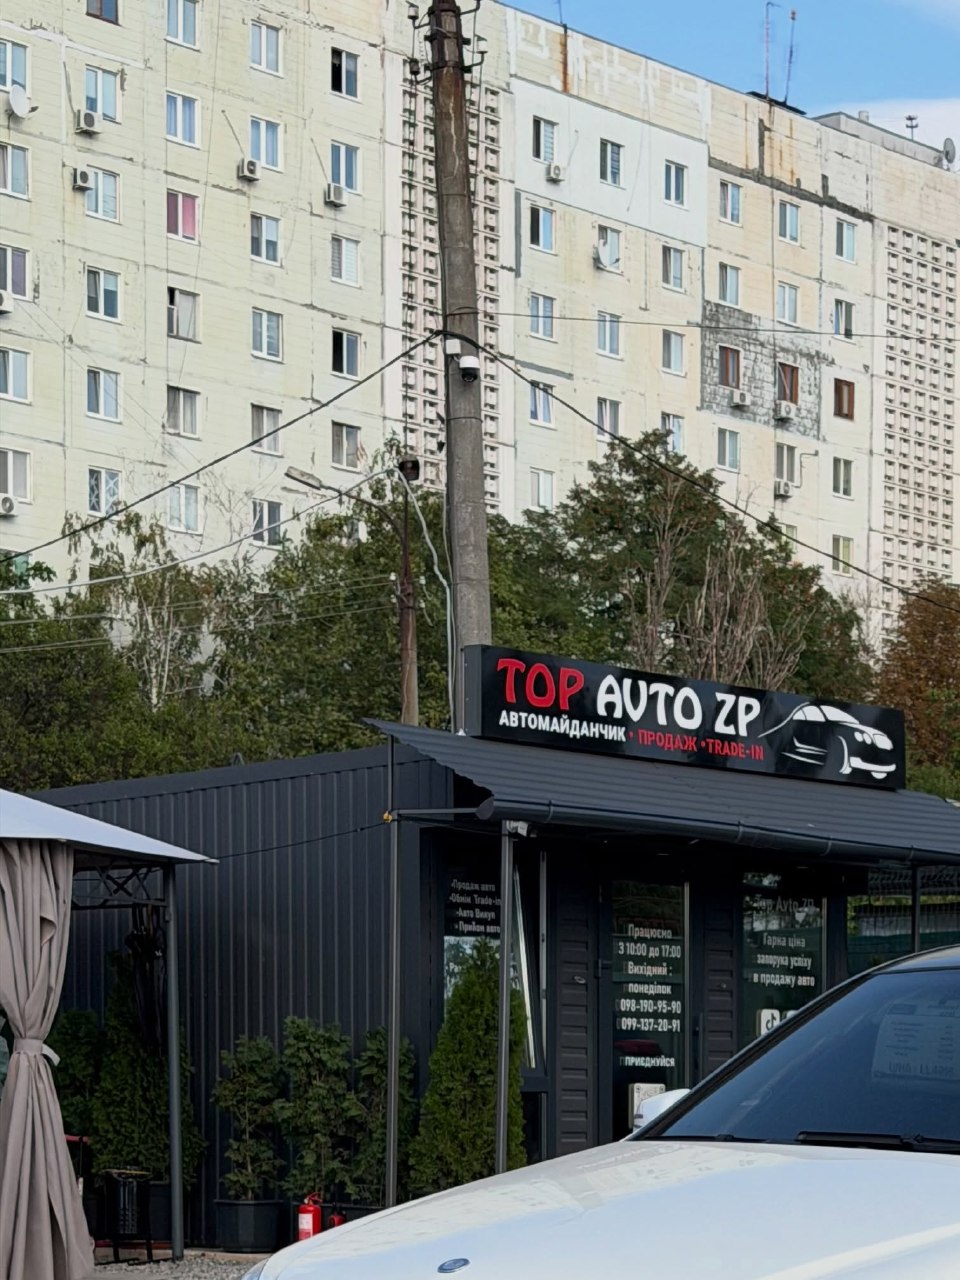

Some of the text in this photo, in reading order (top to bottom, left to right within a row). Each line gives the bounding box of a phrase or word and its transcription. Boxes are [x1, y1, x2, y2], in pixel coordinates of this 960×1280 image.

[497, 658, 585, 710] TOP
[714, 692, 761, 737] ZP
[499, 709, 764, 761] АВТОМАЙДАНЧИК ПРОДАЖ TRADE-IN
[628, 923, 673, 940] Працюємо
[763, 932, 806, 949] Гарна ціна
[626, 942, 647, 956] 10:00
[648, 946, 660, 958] до
[661, 944, 682, 958] 17:00
[627, 961, 668, 977] Вихідний
[757, 953, 812, 970] запорука успіху
[628, 981, 672, 995] понеділок
[760, 973, 796, 988] продажу
[797, 976, 815, 986] авто
[620, 998, 682, 1014] 098-190-95-90
[621, 1017, 681, 1033] 099-137-20-91
[624, 1055, 676, 1069] ПРИЄДНУЙСЯ
